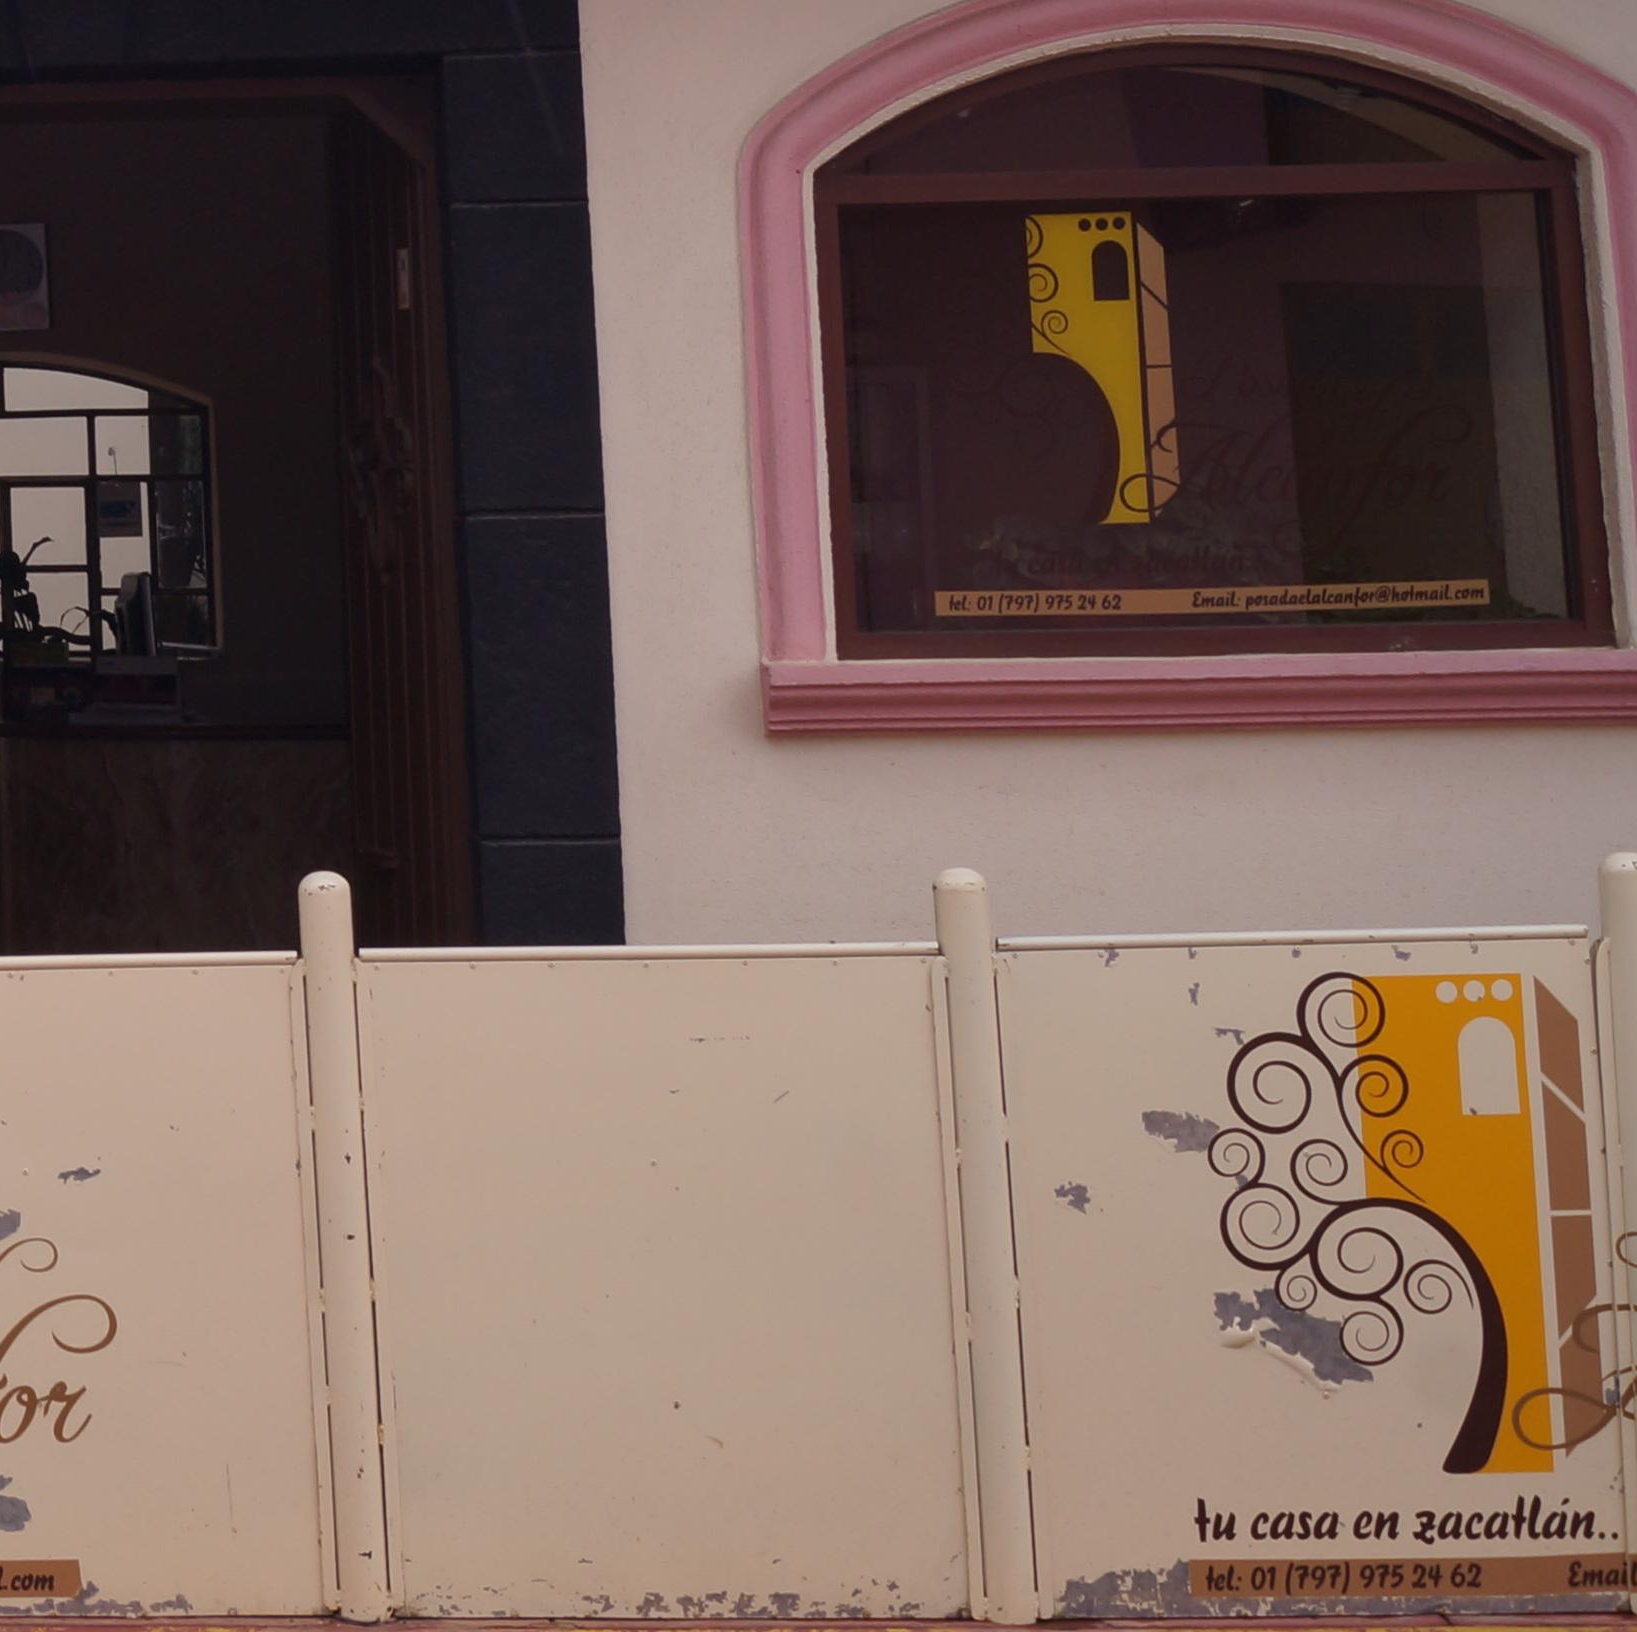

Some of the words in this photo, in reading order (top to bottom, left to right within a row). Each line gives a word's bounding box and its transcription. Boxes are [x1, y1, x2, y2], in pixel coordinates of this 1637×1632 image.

[977, 595, 993, 611] 01
[998, 593, 1039, 614] (797)
[1045, 595, 1072, 611] 975
[1077, 594, 1096, 610] 24
[1102, 594, 1121, 610] 62
[1194, 1497, 1237, 1543] tu
[1250, 1509, 1339, 1541] casa
[1353, 1510, 1400, 1540] en
[1205, 1563, 1243, 1592] tel:
[1251, 1565, 1277, 1591] 01
[1284, 1562, 1351, 1595] (797)
[1359, 1565, 1405, 1589] 975
[1411, 1564, 1444, 1589] 24
[1450, 1564, 1483, 1589] 62
